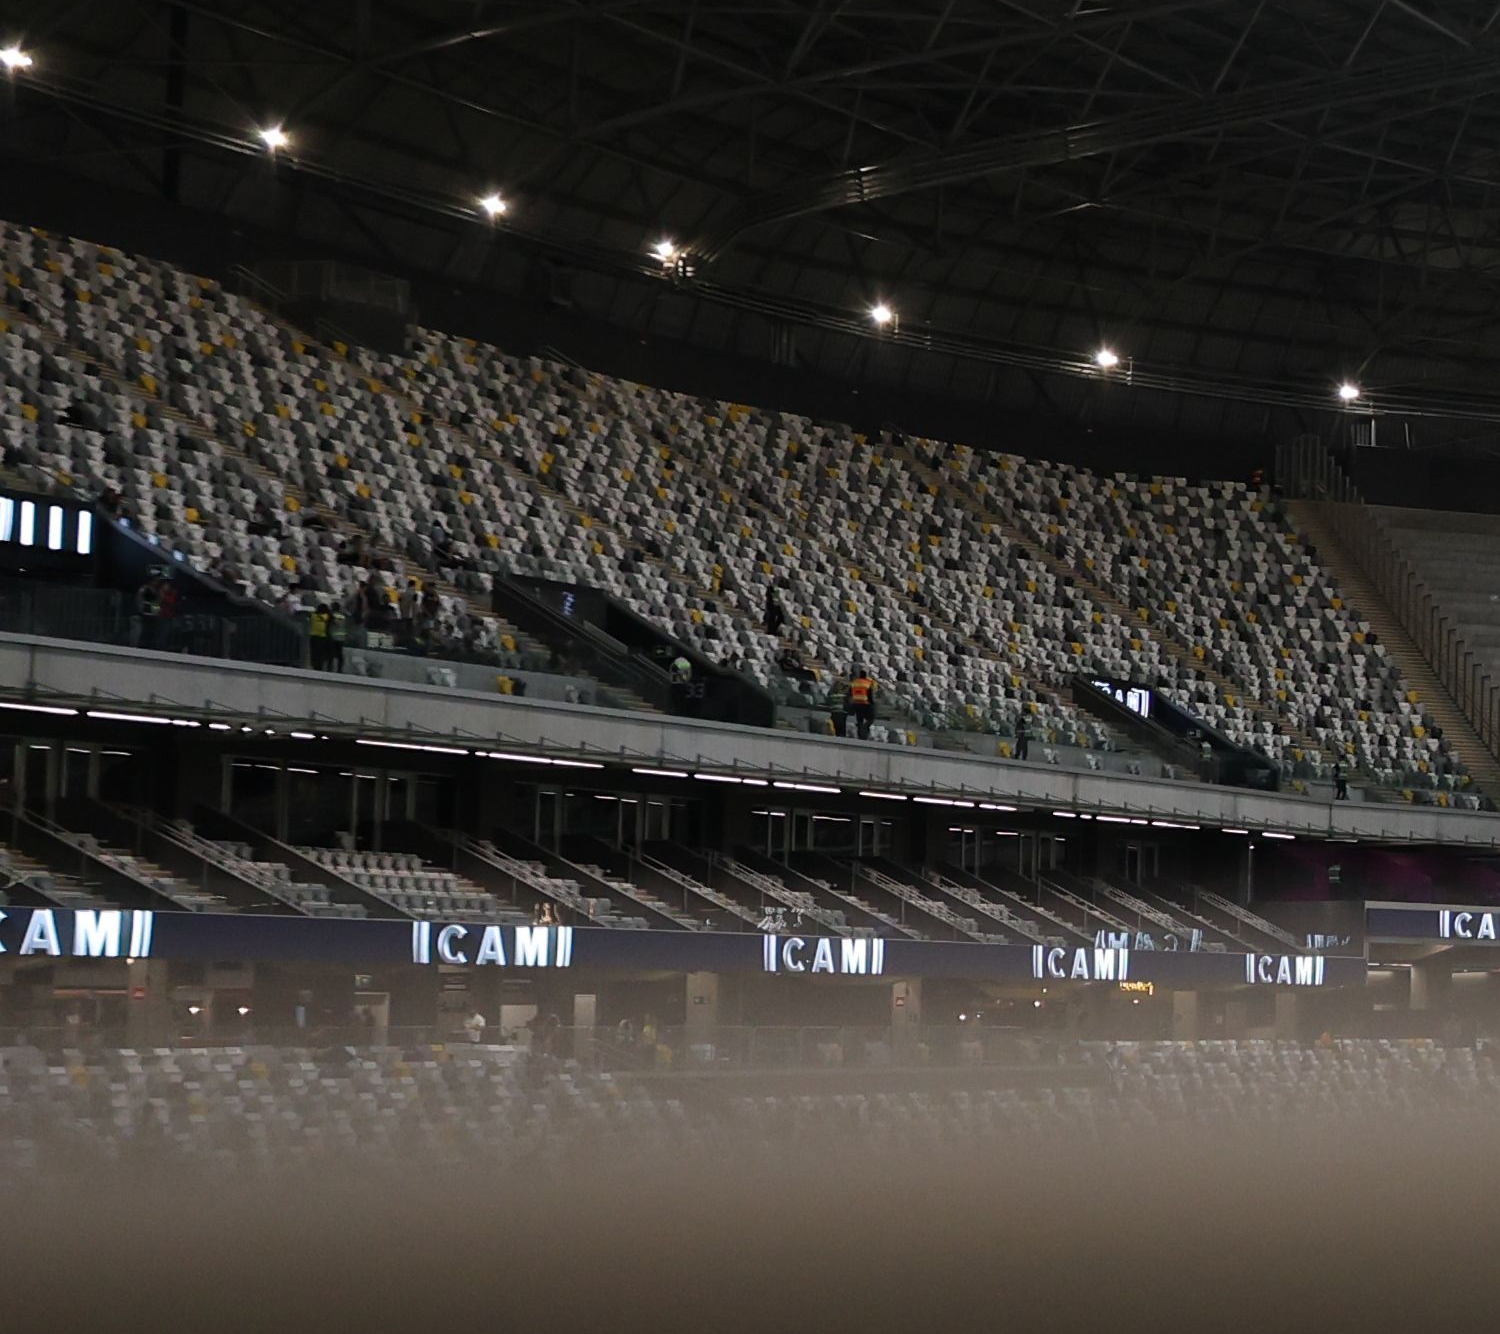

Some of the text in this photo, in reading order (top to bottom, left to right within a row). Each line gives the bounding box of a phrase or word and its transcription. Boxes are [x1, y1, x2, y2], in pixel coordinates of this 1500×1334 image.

[0, 909, 121, 957] AM
[438, 925, 549, 966] CAM
[783, 938, 866, 974] CAM
